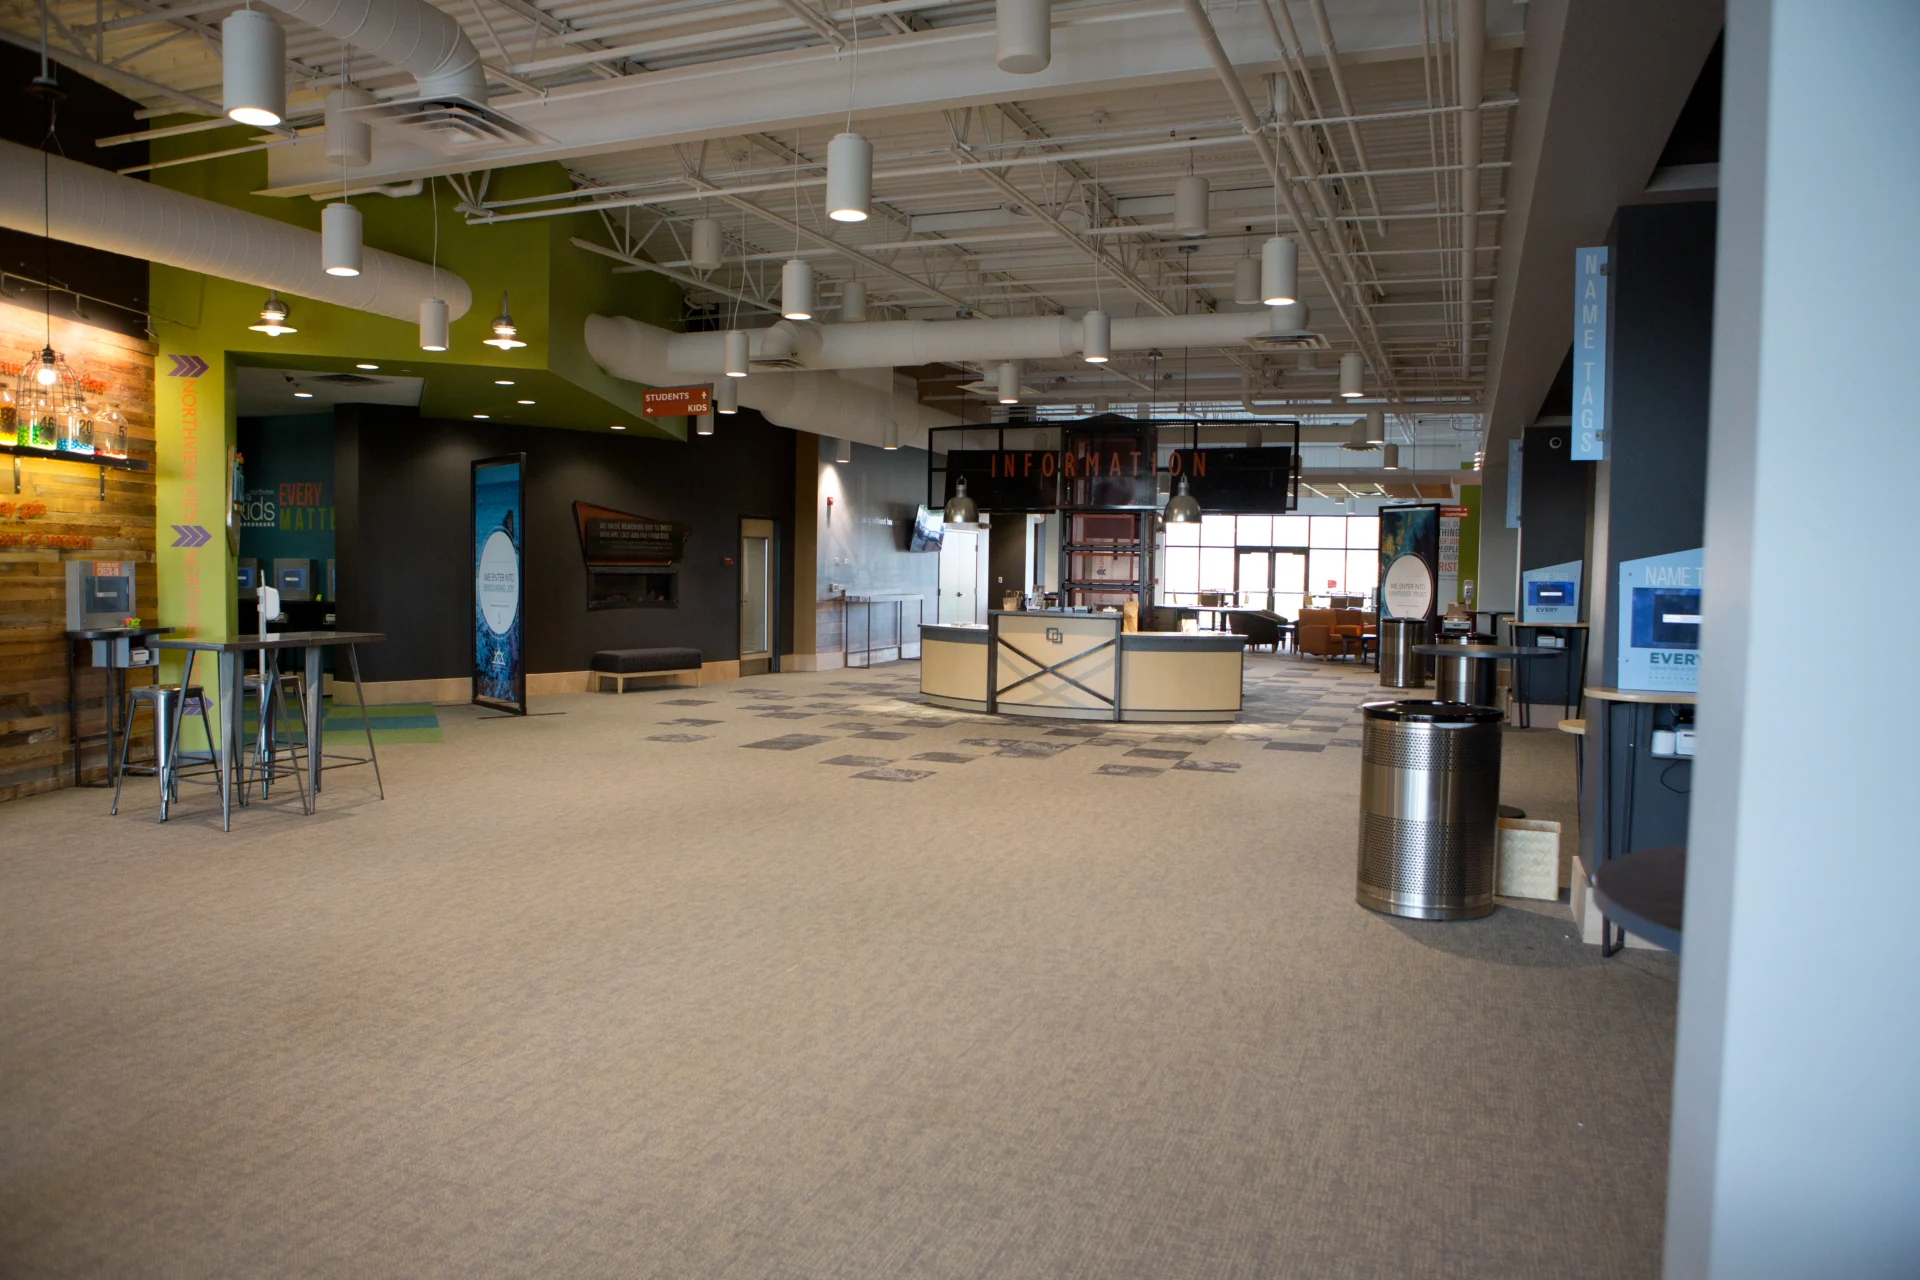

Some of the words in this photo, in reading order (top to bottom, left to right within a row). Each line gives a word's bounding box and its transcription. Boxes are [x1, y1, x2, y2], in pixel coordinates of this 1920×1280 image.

[1582, 254, 1598, 349] NAME
[645, 392, 690, 402] STUDENTS
[1580, 361, 1595, 452] TAGS
[687, 403, 708, 412] KIDS
[181, 379, 198, 482] NORTHVIEW
[991, 451, 1206, 478] INFORMATION
[279, 482, 323, 507] EVERY
[20, 500, 47, 520] gain
[183, 487, 199, 523] KIDS
[46, 533, 94, 550] wisdom
[491, 572, 505, 583] ENTER
[505, 573, 515, 583] INTO
[1645, 566, 1691, 586] NAME
[1390, 582, 1398, 590] WE
[1399, 582, 1414, 590] ENTER
[1415, 583, 1426, 591] INTO
